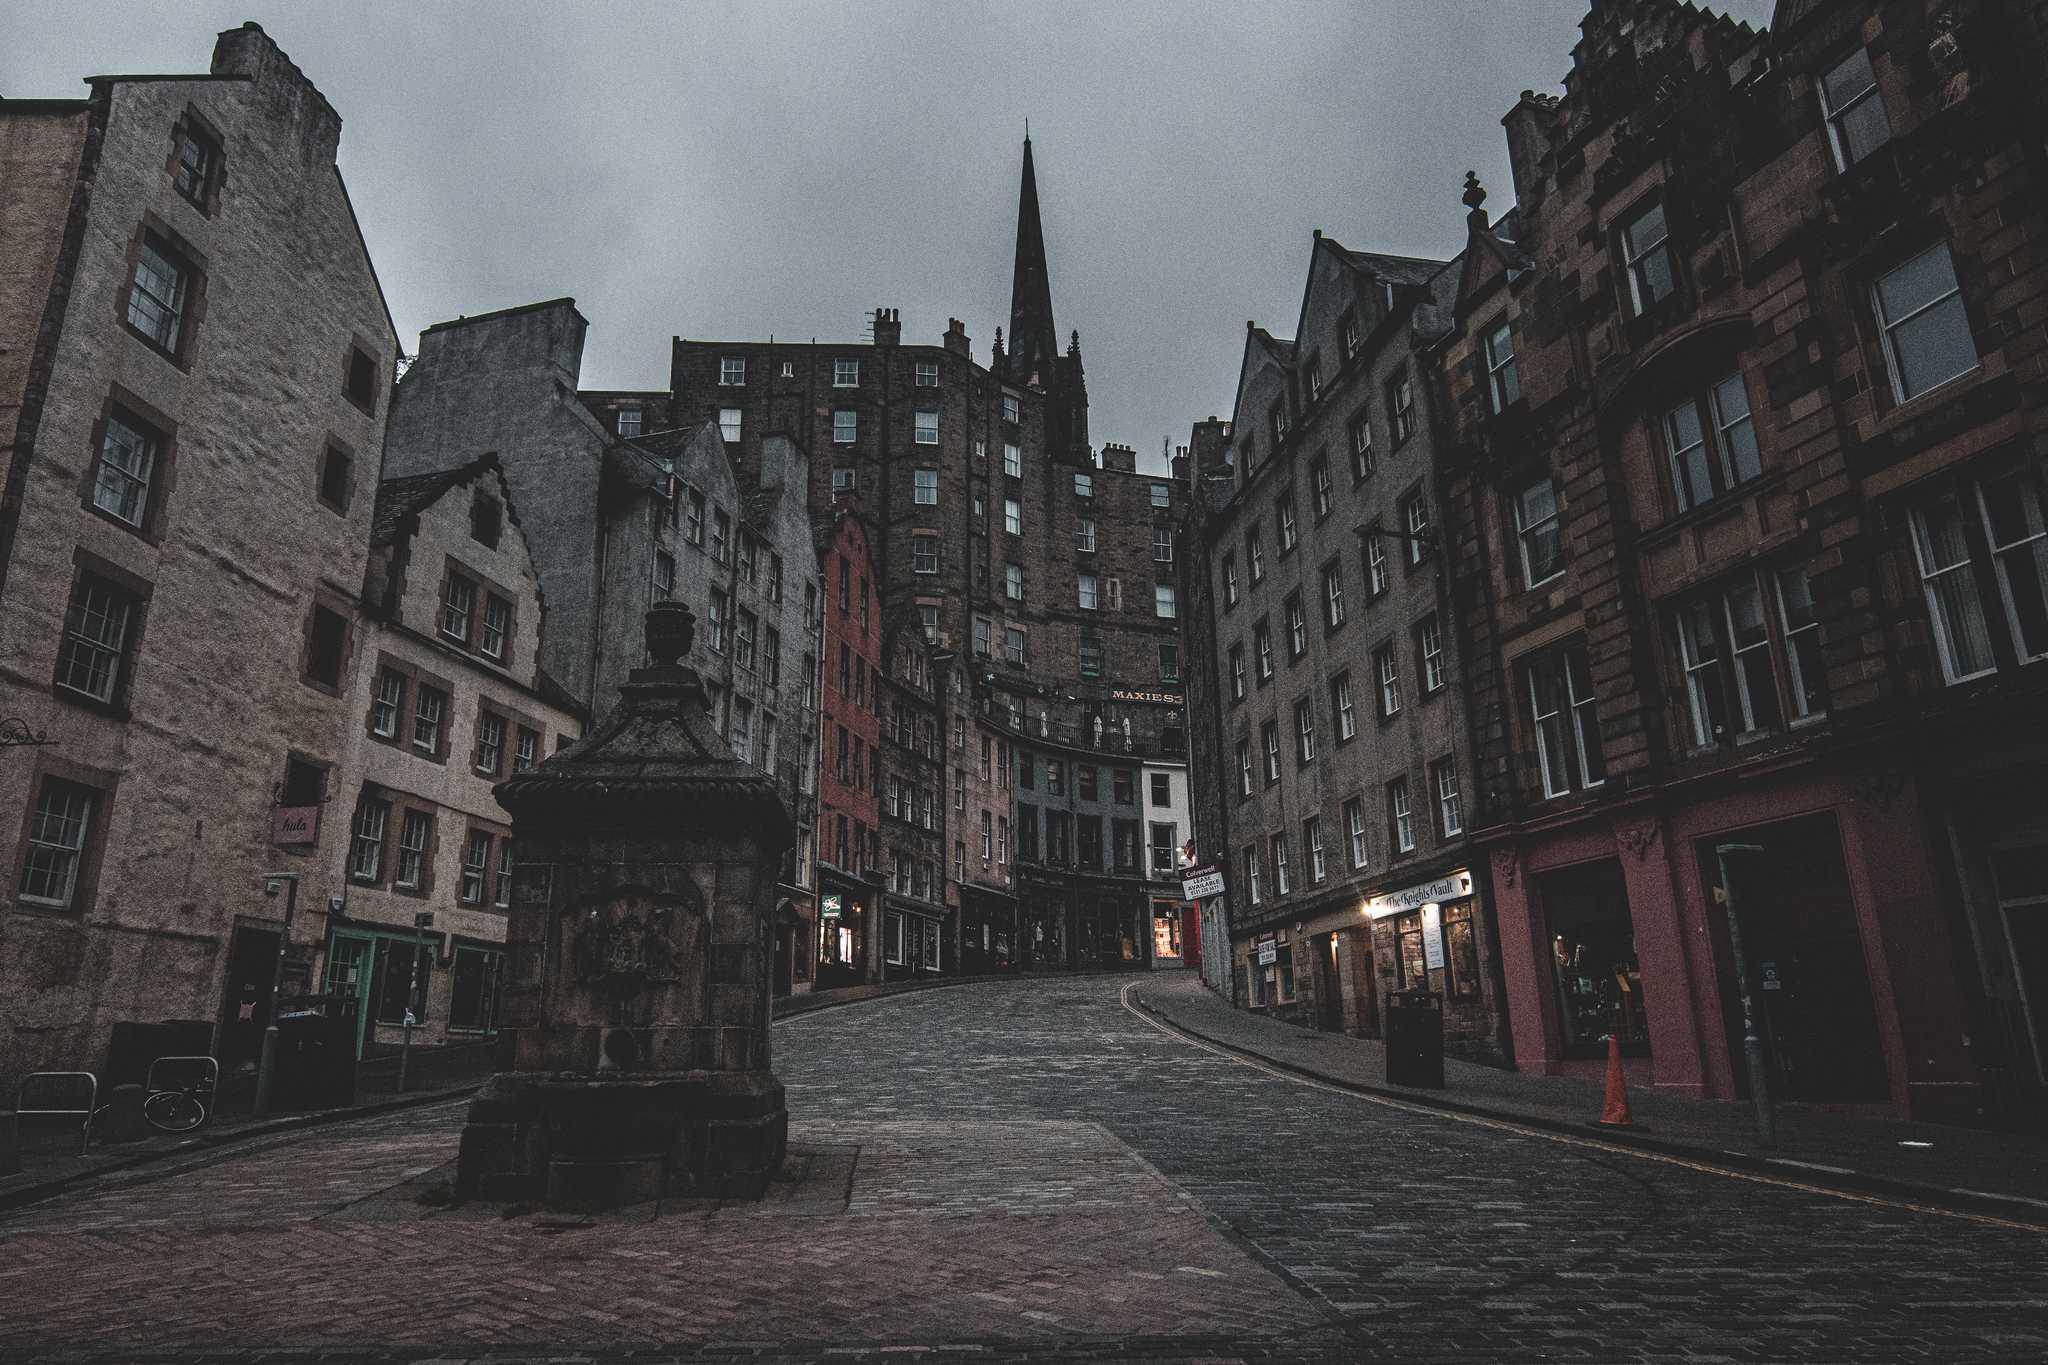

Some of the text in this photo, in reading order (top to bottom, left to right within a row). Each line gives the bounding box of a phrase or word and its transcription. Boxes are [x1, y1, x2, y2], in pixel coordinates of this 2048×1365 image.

[1112, 690, 1174, 703] MAXIES
[282, 817, 306, 832] hula
[1188, 879, 1220, 891] AVAILABLE
[1386, 880, 1454, 907] The Knights Vault
